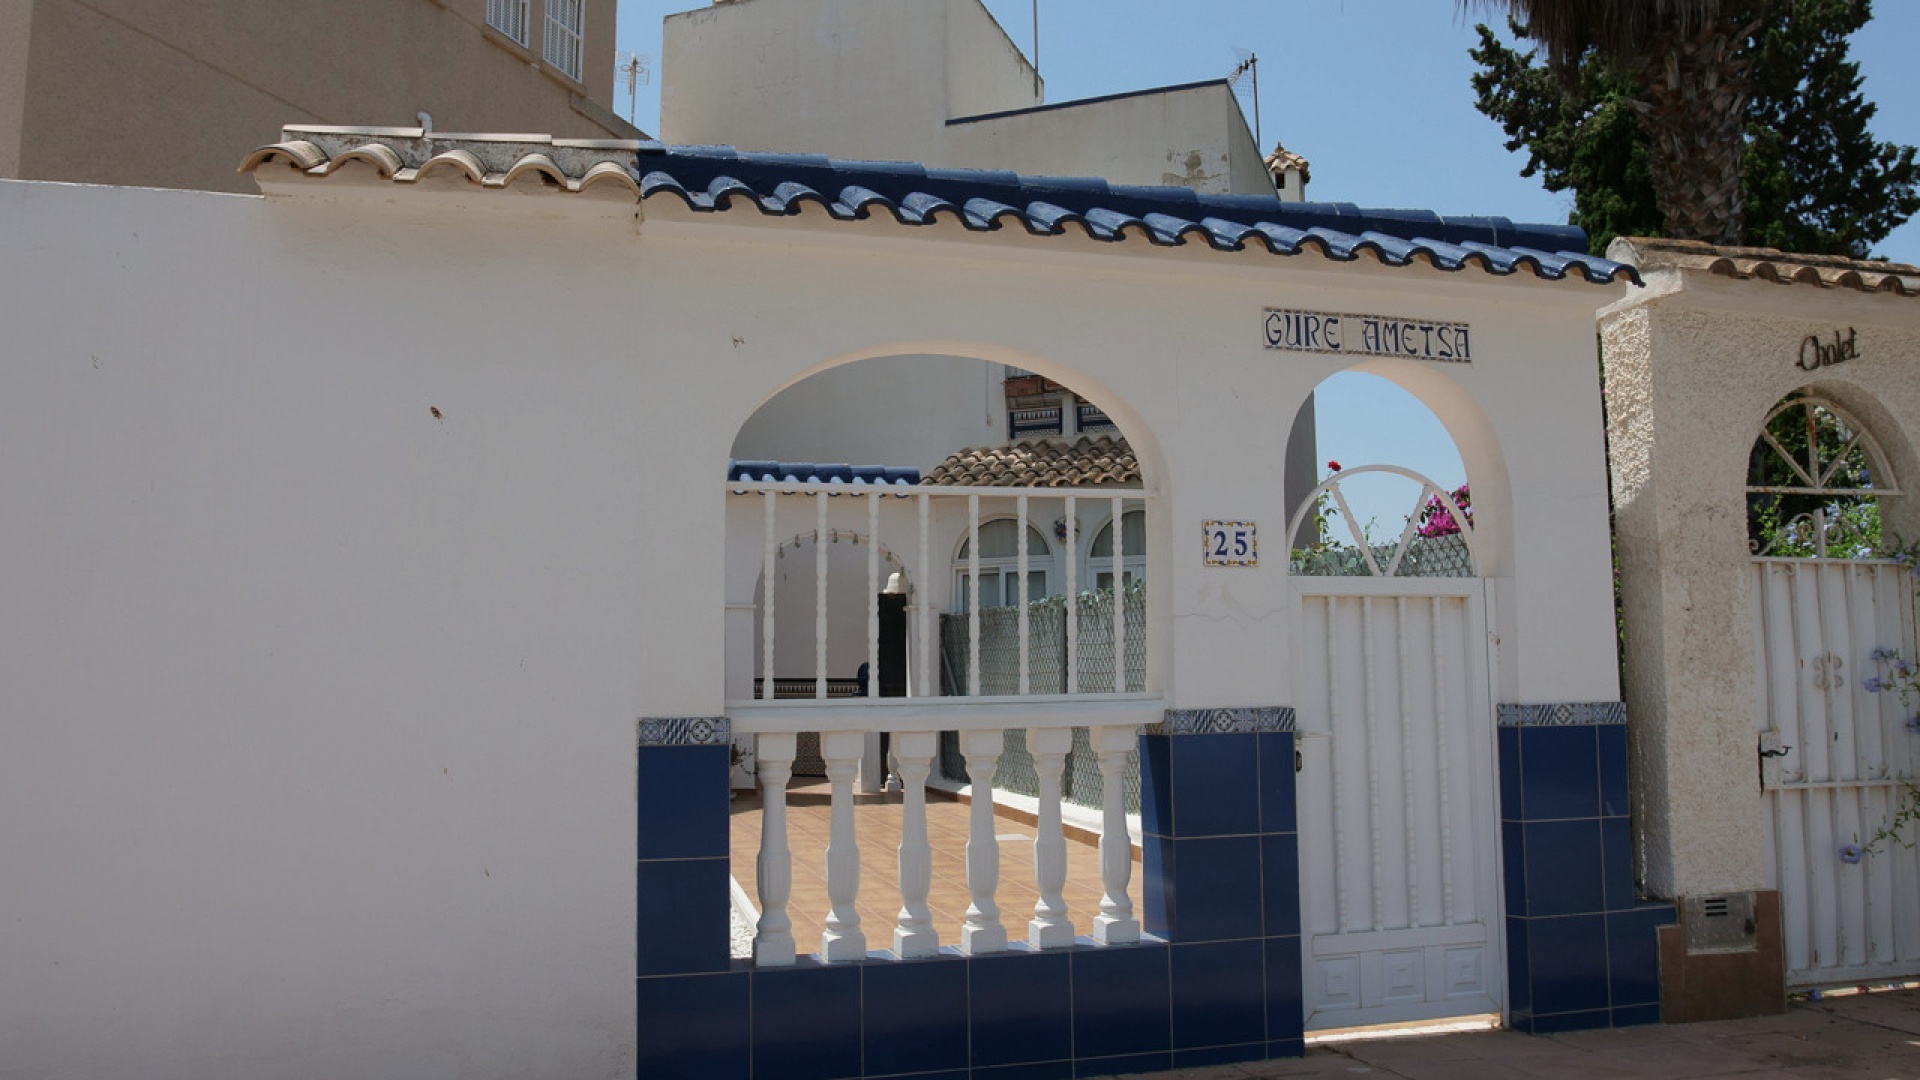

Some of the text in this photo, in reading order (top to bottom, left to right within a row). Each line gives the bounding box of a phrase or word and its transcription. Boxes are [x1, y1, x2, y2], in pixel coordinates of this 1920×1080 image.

[1264, 312, 1471, 358] GURE AMETSA
[1795, 326, 1861, 371] Chalet
[1214, 530, 1248, 556] 25
